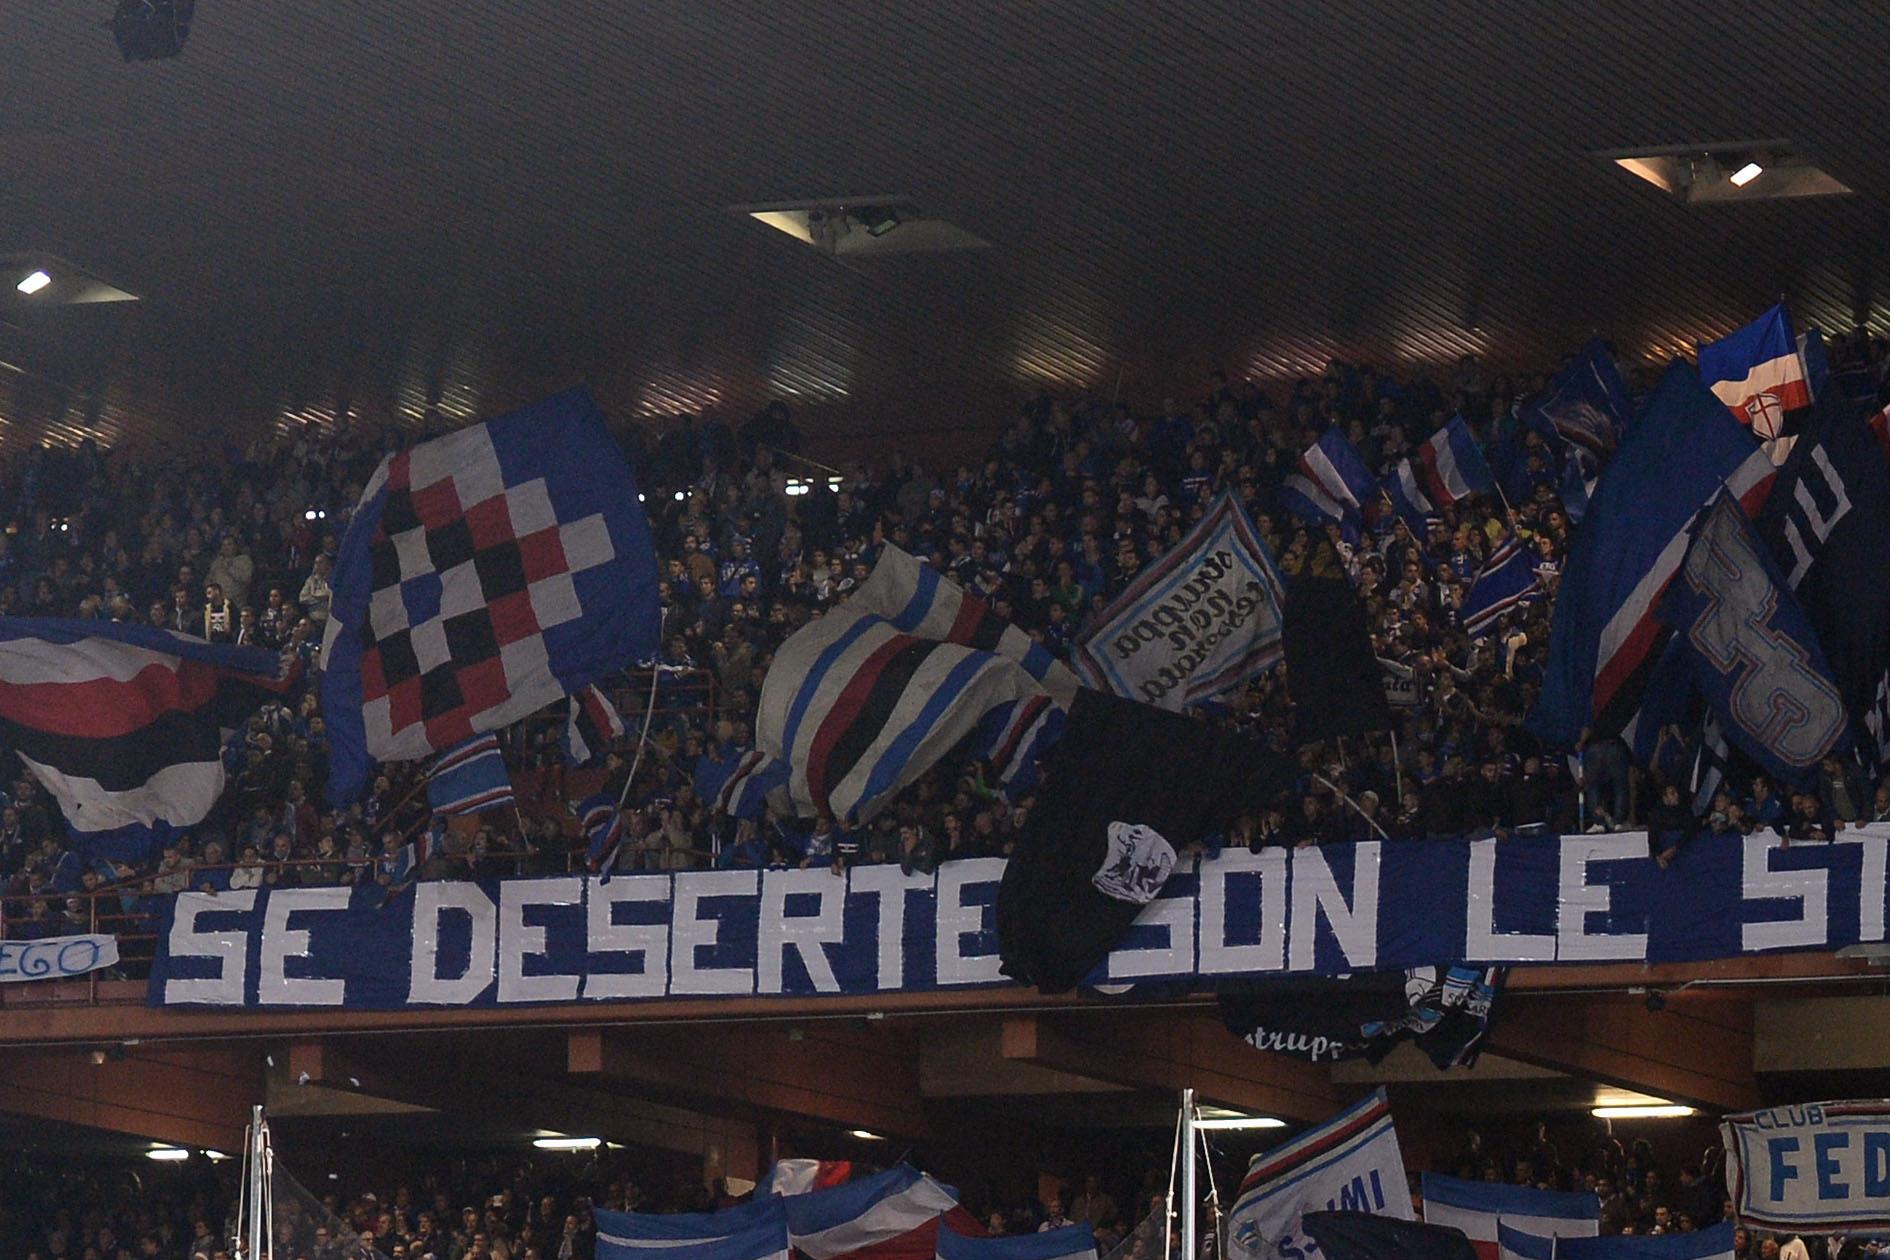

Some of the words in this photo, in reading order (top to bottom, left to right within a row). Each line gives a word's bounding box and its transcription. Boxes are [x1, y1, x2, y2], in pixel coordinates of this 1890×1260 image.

[165, 888, 353, 1005] SE
[406, 858, 1010, 1005] DESERTE
[1109, 838, 1381, 975] SON
[1466, 832, 1649, 961] LE
[1755, 1103, 1825, 1130] CLUB
